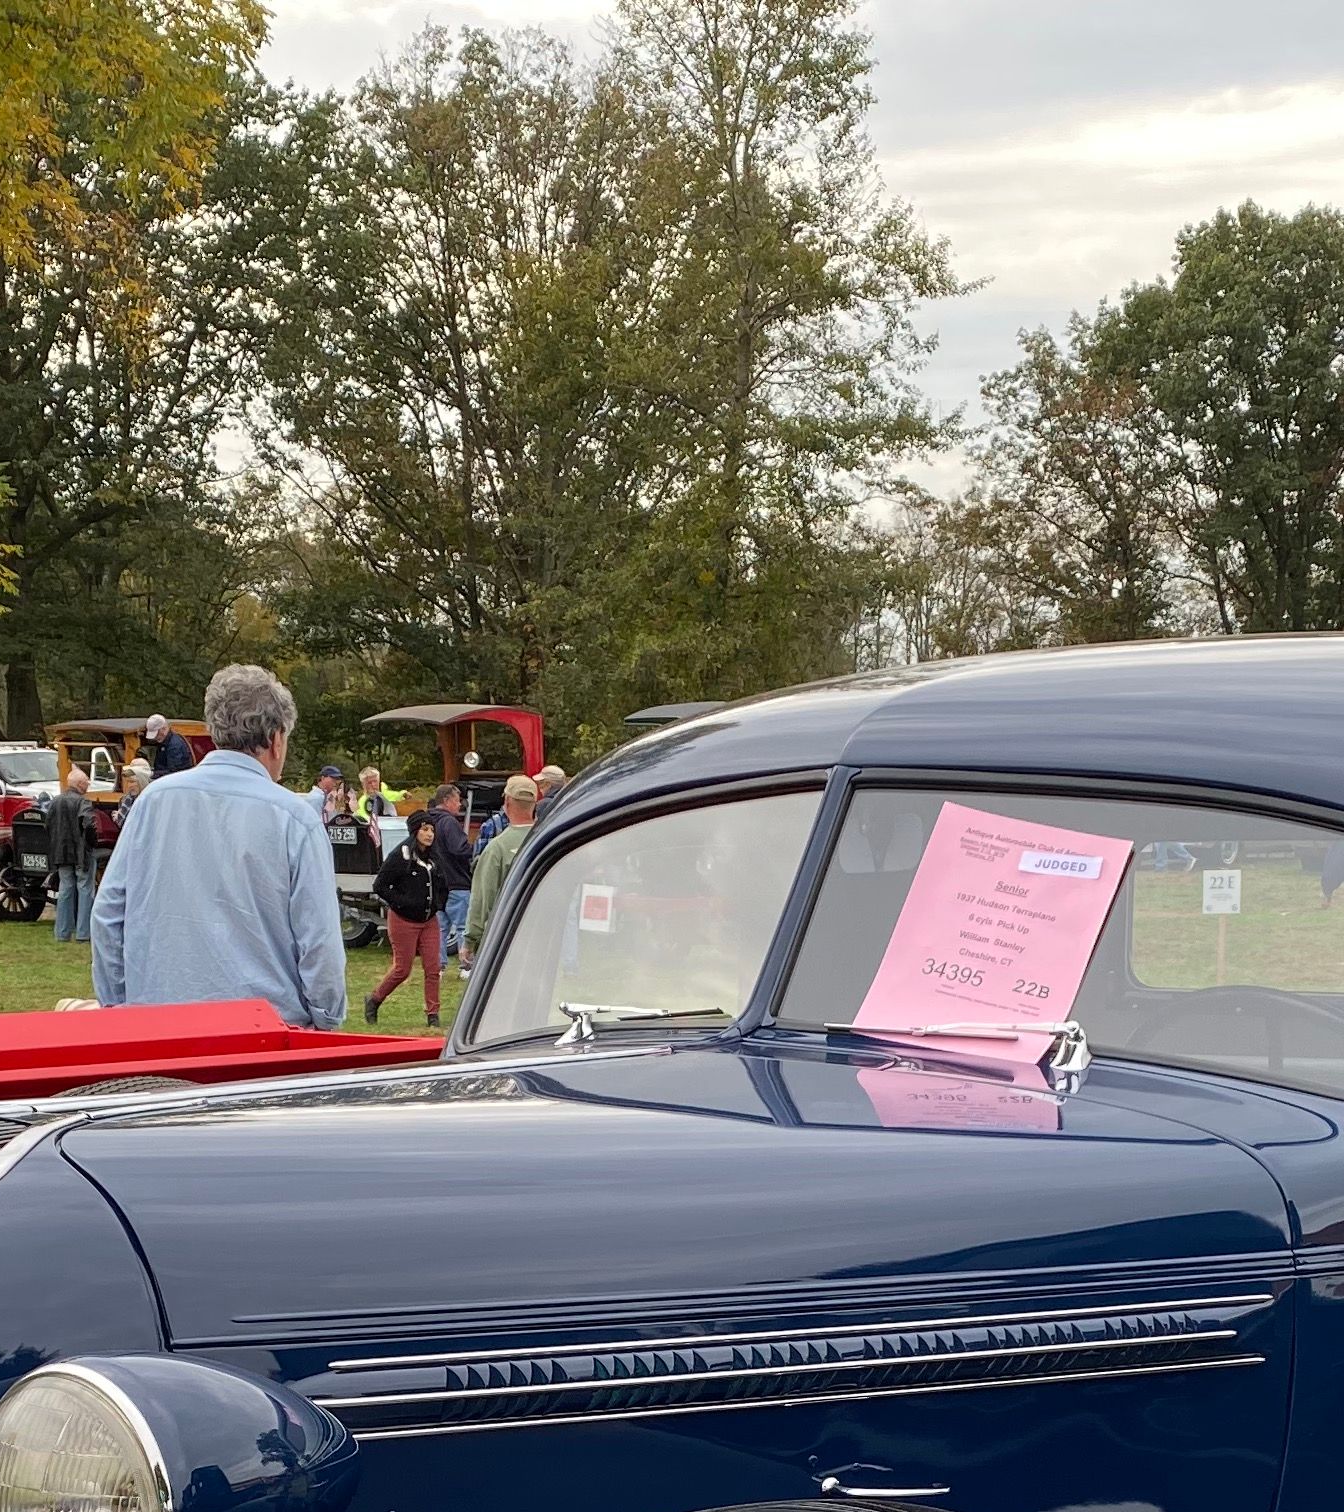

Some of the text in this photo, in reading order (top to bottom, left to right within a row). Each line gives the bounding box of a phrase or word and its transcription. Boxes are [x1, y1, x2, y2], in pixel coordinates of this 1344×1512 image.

[1034, 858, 1088, 873] JUDGED
[995, 880, 1030, 896] Senior
[956, 892, 1056, 922] 1937 Hudson Terraplane
[996, 919, 1015, 931] Pick
[1017, 924, 1030, 935] Up
[959, 929, 1026, 954] William Stanley
[999, 957, 1014, 967] CT
[921, 957, 1051, 999] 34395 22B
